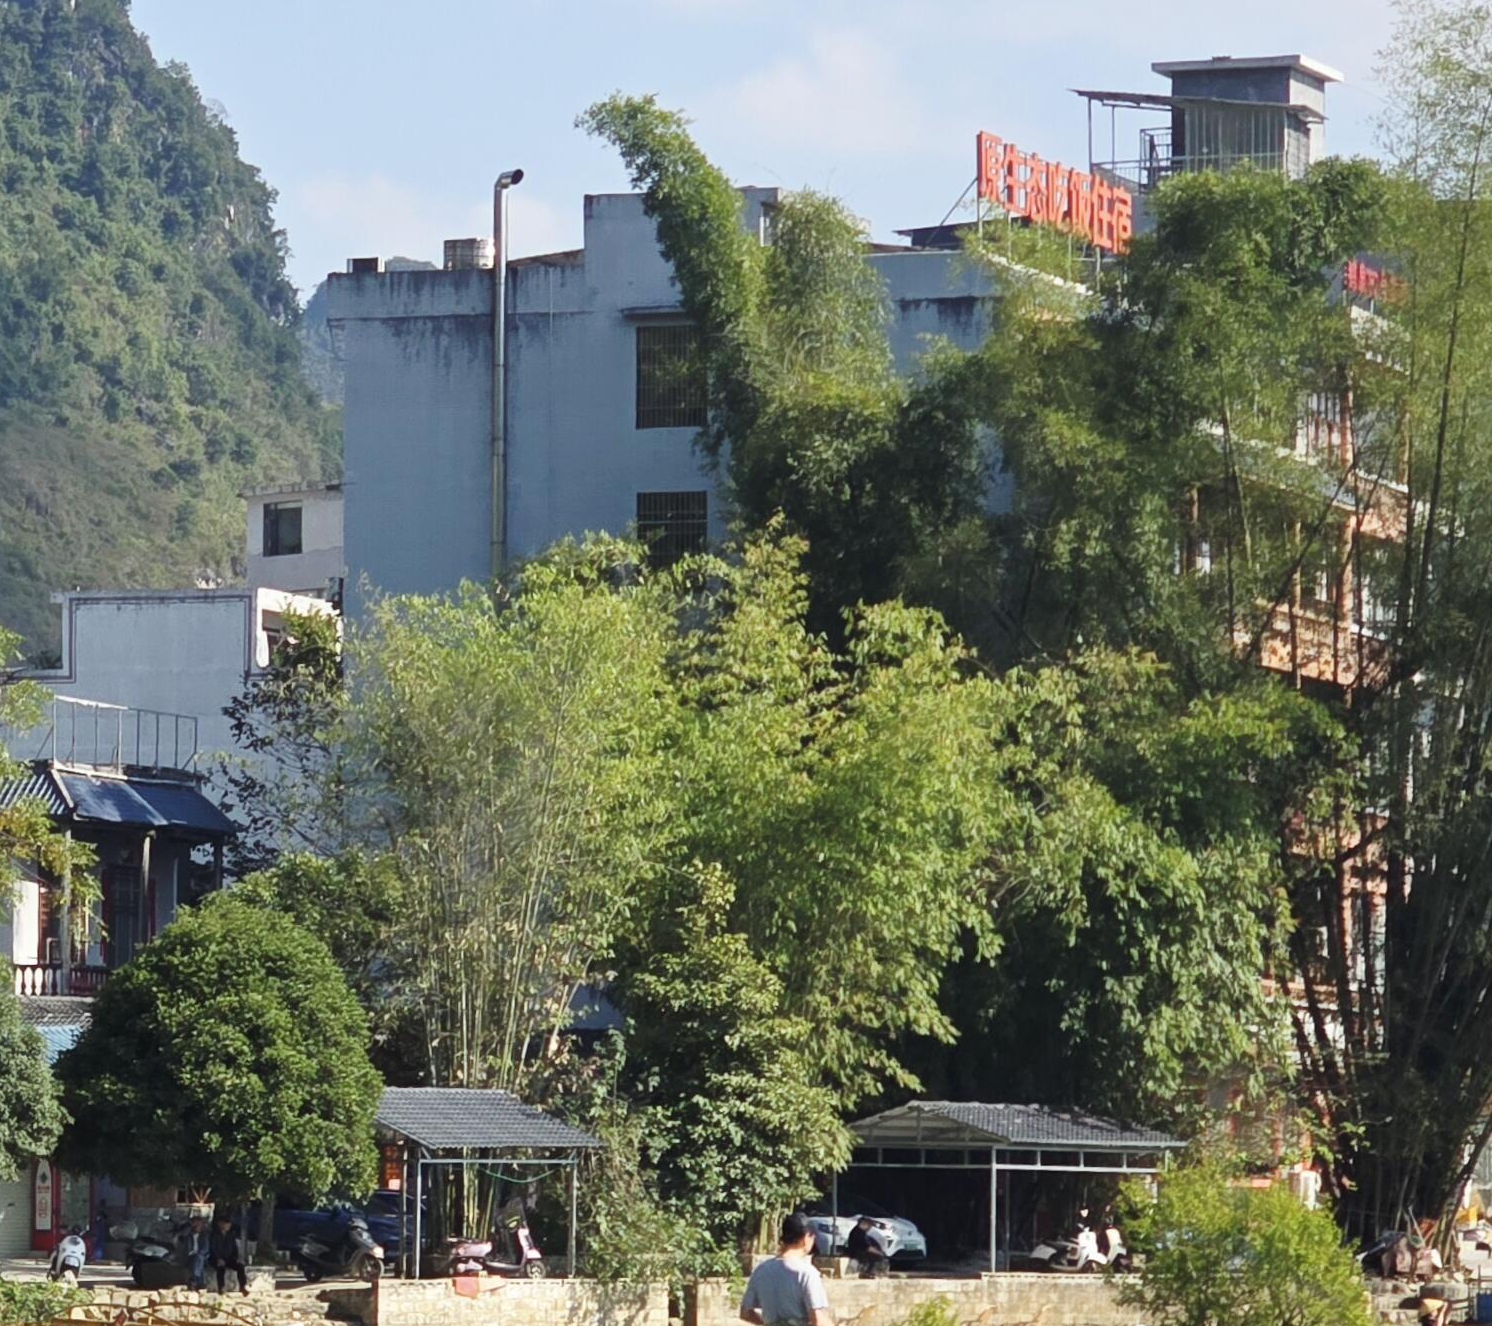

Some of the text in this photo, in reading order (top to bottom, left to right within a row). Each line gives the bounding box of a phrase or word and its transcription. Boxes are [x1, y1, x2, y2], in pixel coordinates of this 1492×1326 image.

[977, 131, 1133, 255] 原生态吃饭住宿
